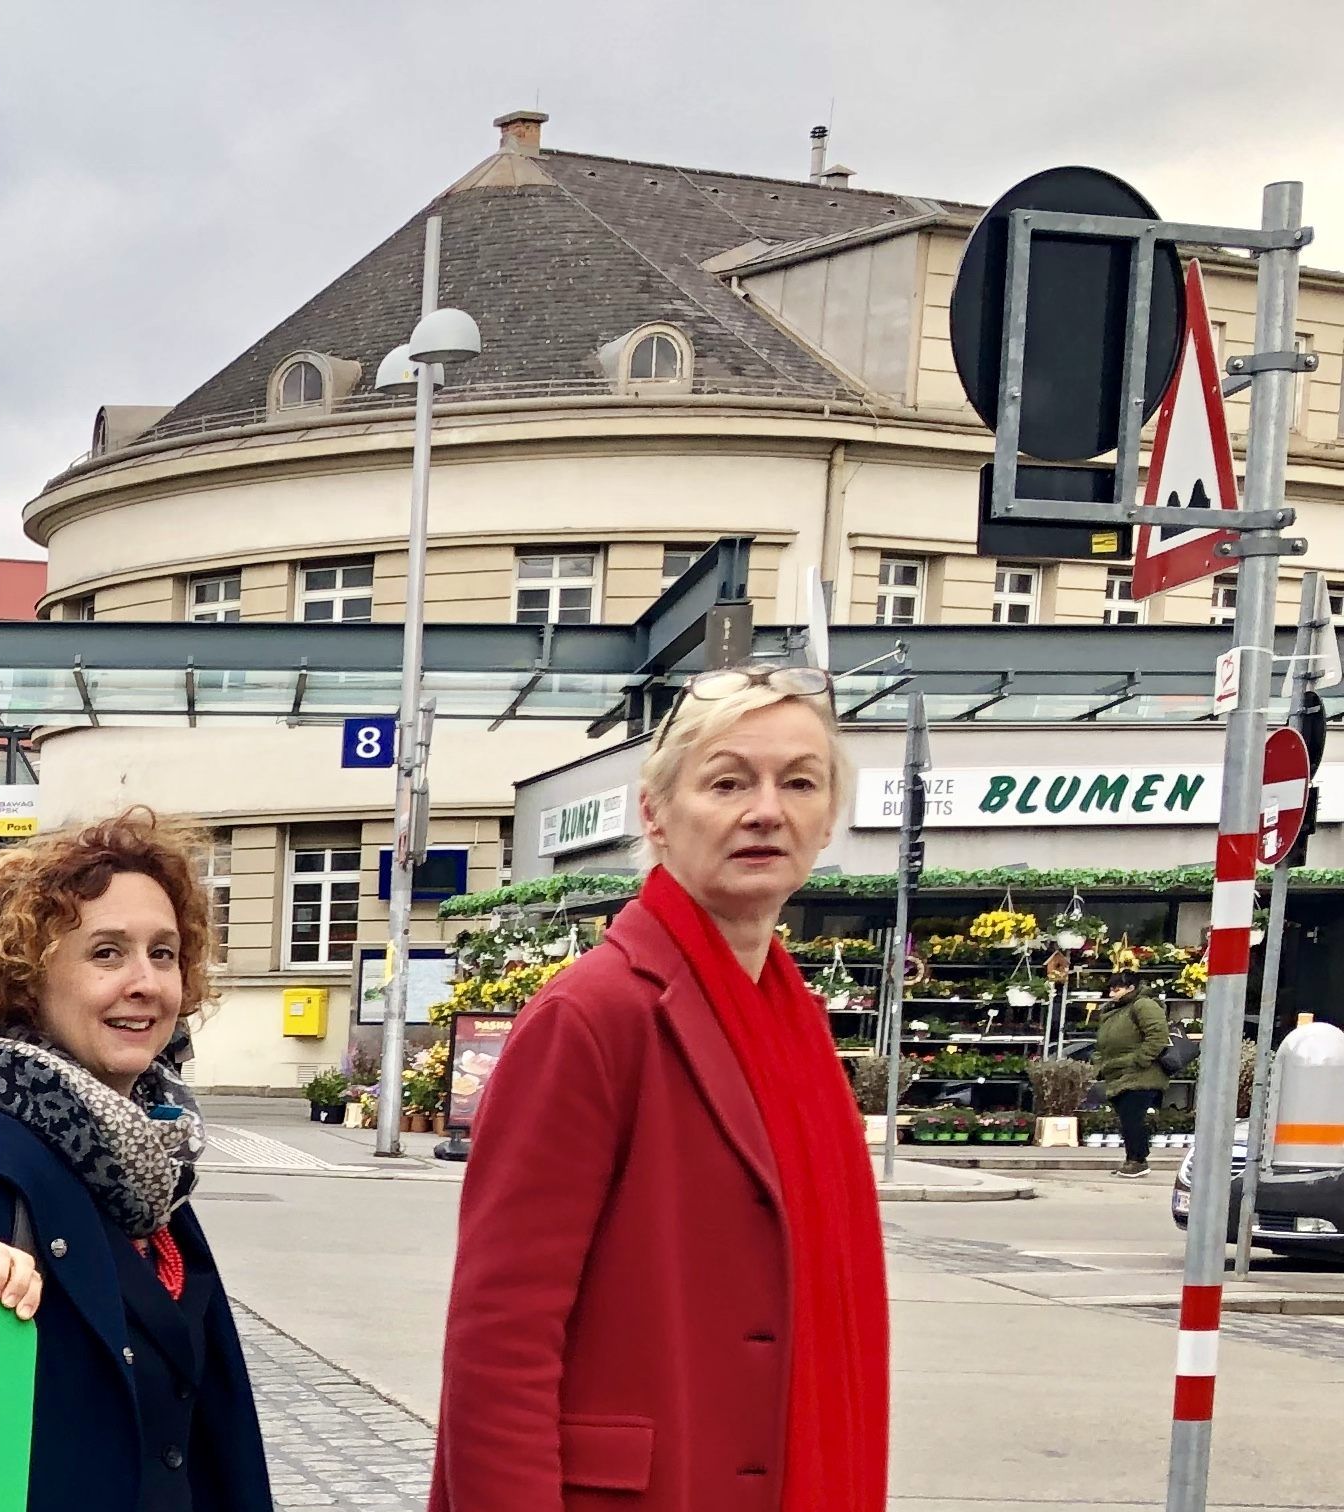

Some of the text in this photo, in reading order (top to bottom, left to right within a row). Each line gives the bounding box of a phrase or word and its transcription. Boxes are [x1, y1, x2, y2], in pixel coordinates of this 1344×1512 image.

[356, 727, 381, 758] 8
[885, 779, 955, 795] KRNZE
[979, 774, 1205, 814] BLUMEN
[883, 800, 954, 816] BUTTS
[7, 823, 32, 831] Post
